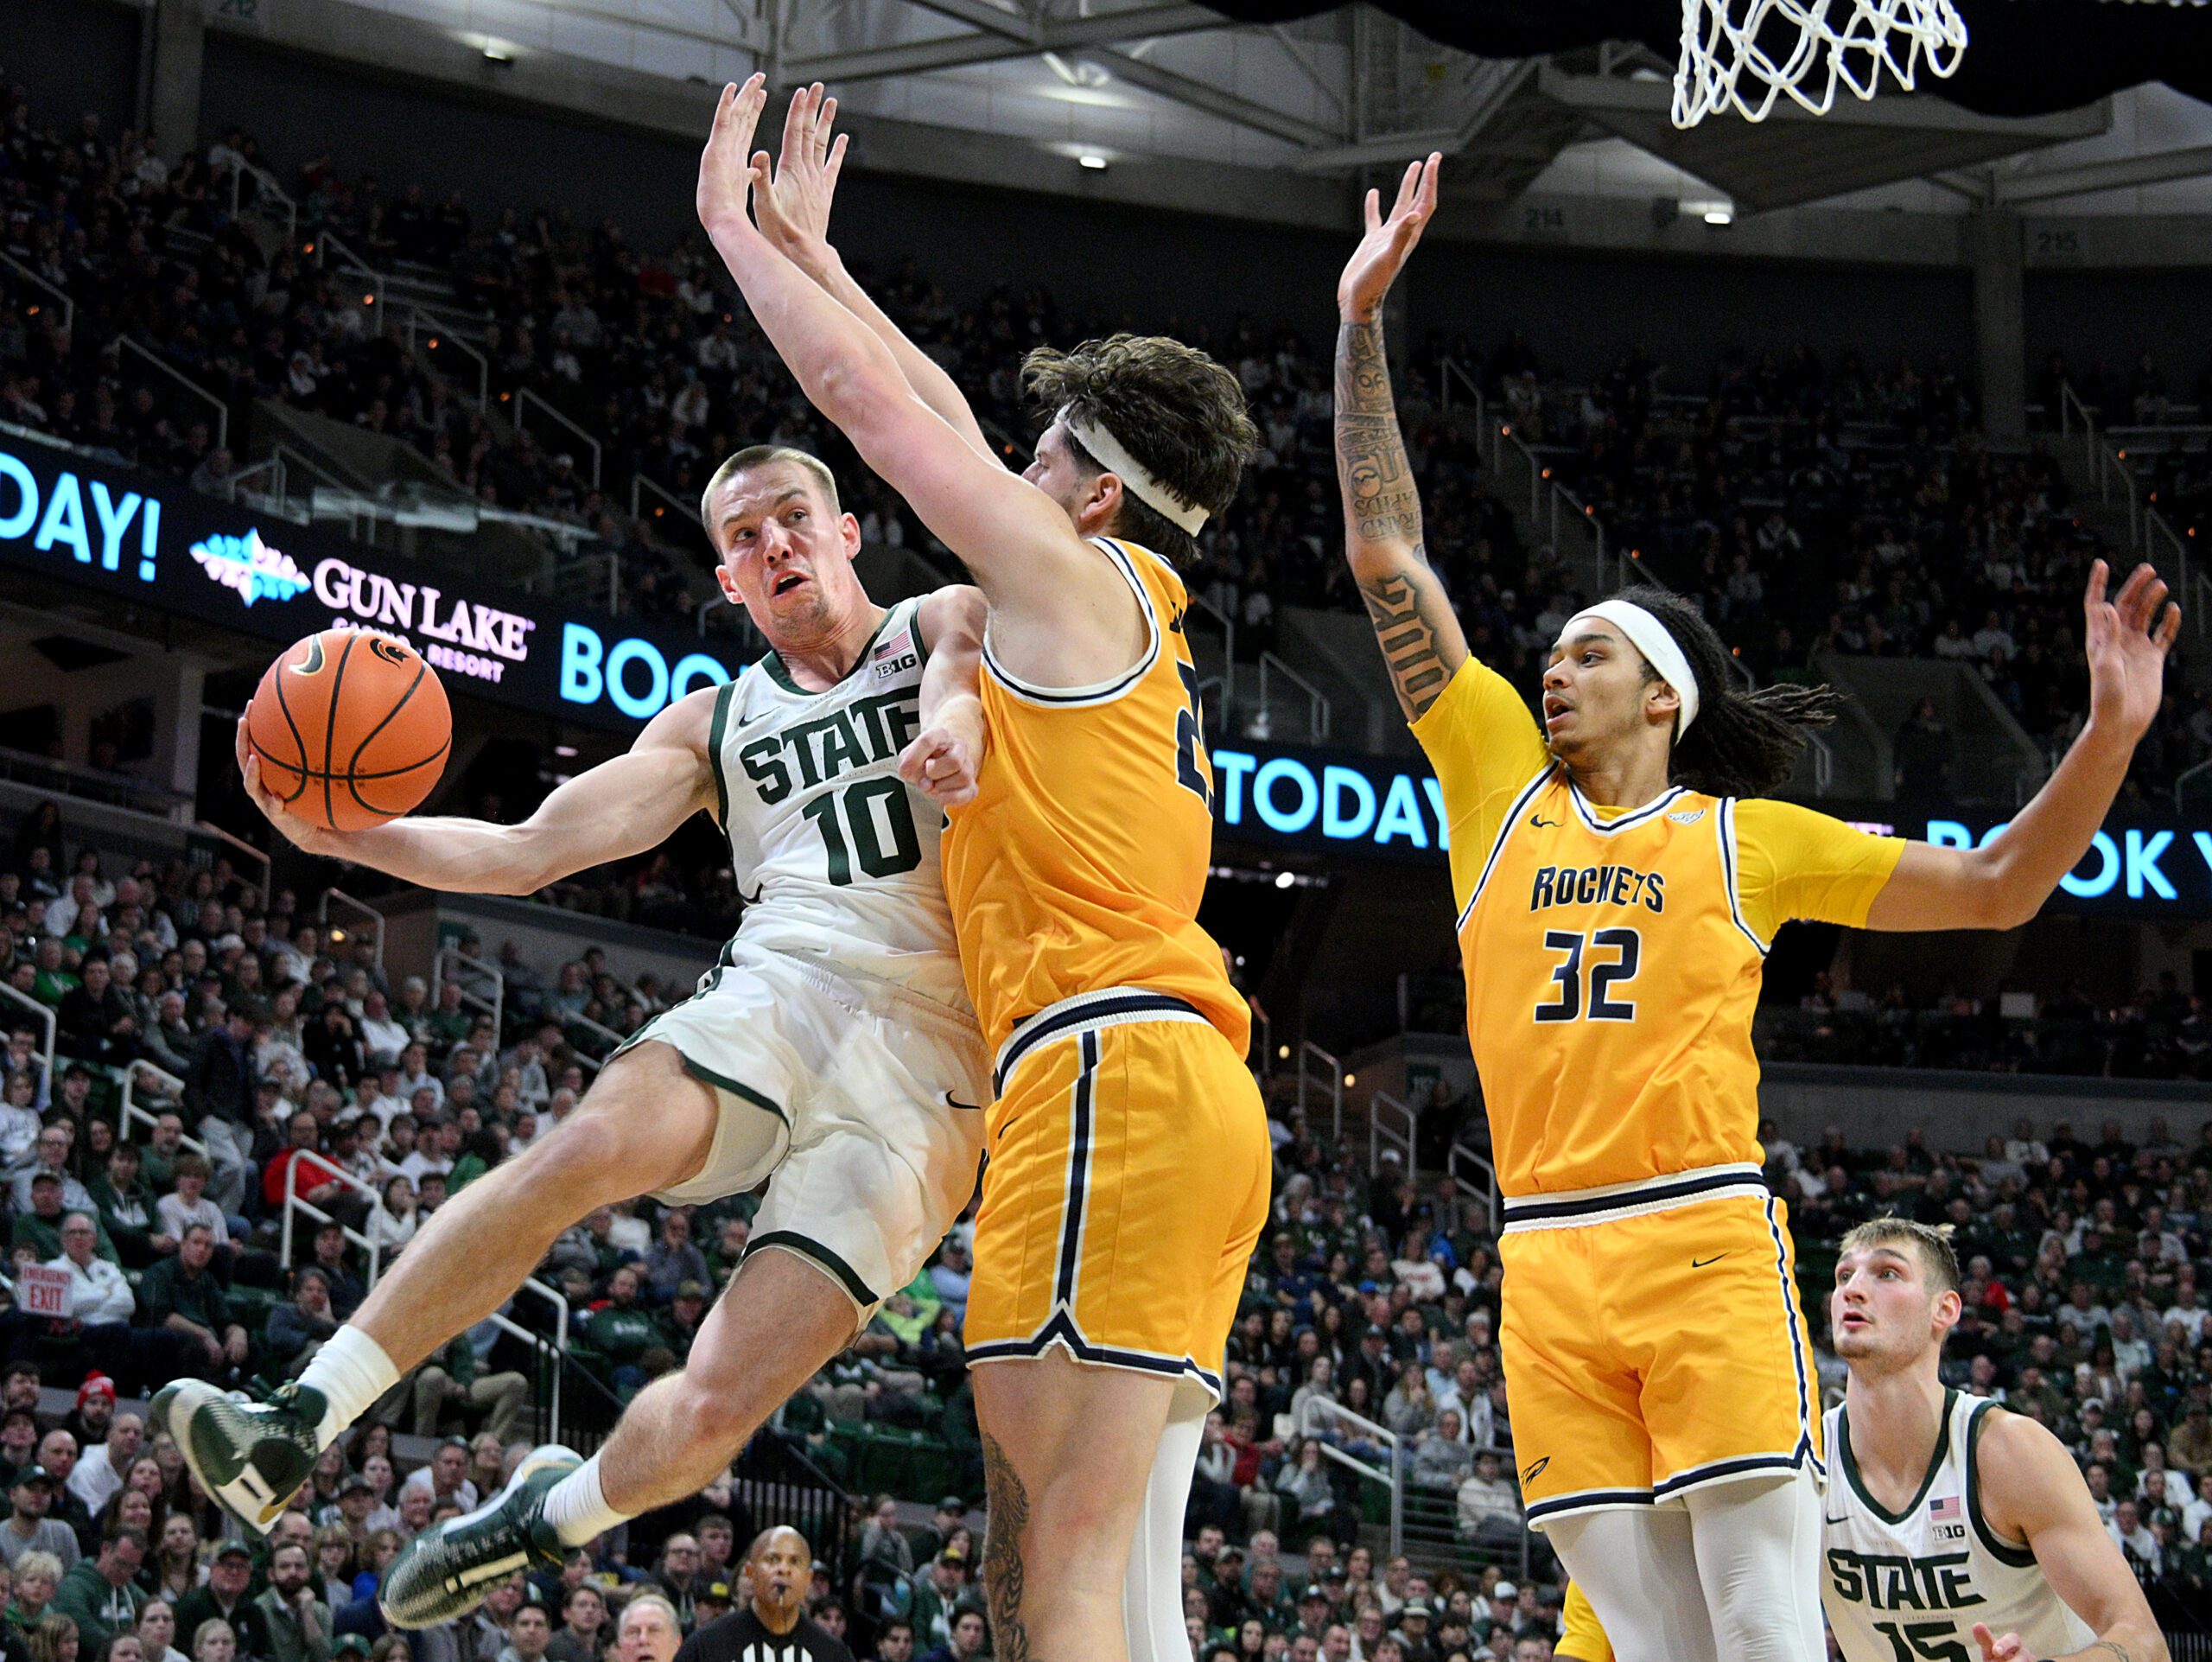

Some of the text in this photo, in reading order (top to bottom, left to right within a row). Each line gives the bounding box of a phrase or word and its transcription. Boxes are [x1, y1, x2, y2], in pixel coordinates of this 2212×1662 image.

[1525, 208, 1562, 227] 214
[2037, 232, 2076, 252] 215
[314, 557, 416, 629] GUN
[417, 586, 528, 662] LAKE
[427, 644, 505, 684] RESORT
[560, 621, 751, 719] BOO
[740, 684, 920, 806] STATE
[802, 775, 923, 887] 10
[1530, 865, 1666, 914] ROCKETS
[1533, 927, 1643, 1023] 32
[29, 1283, 63, 1312] EXIT
[1826, 1548, 1988, 1610] STATE
